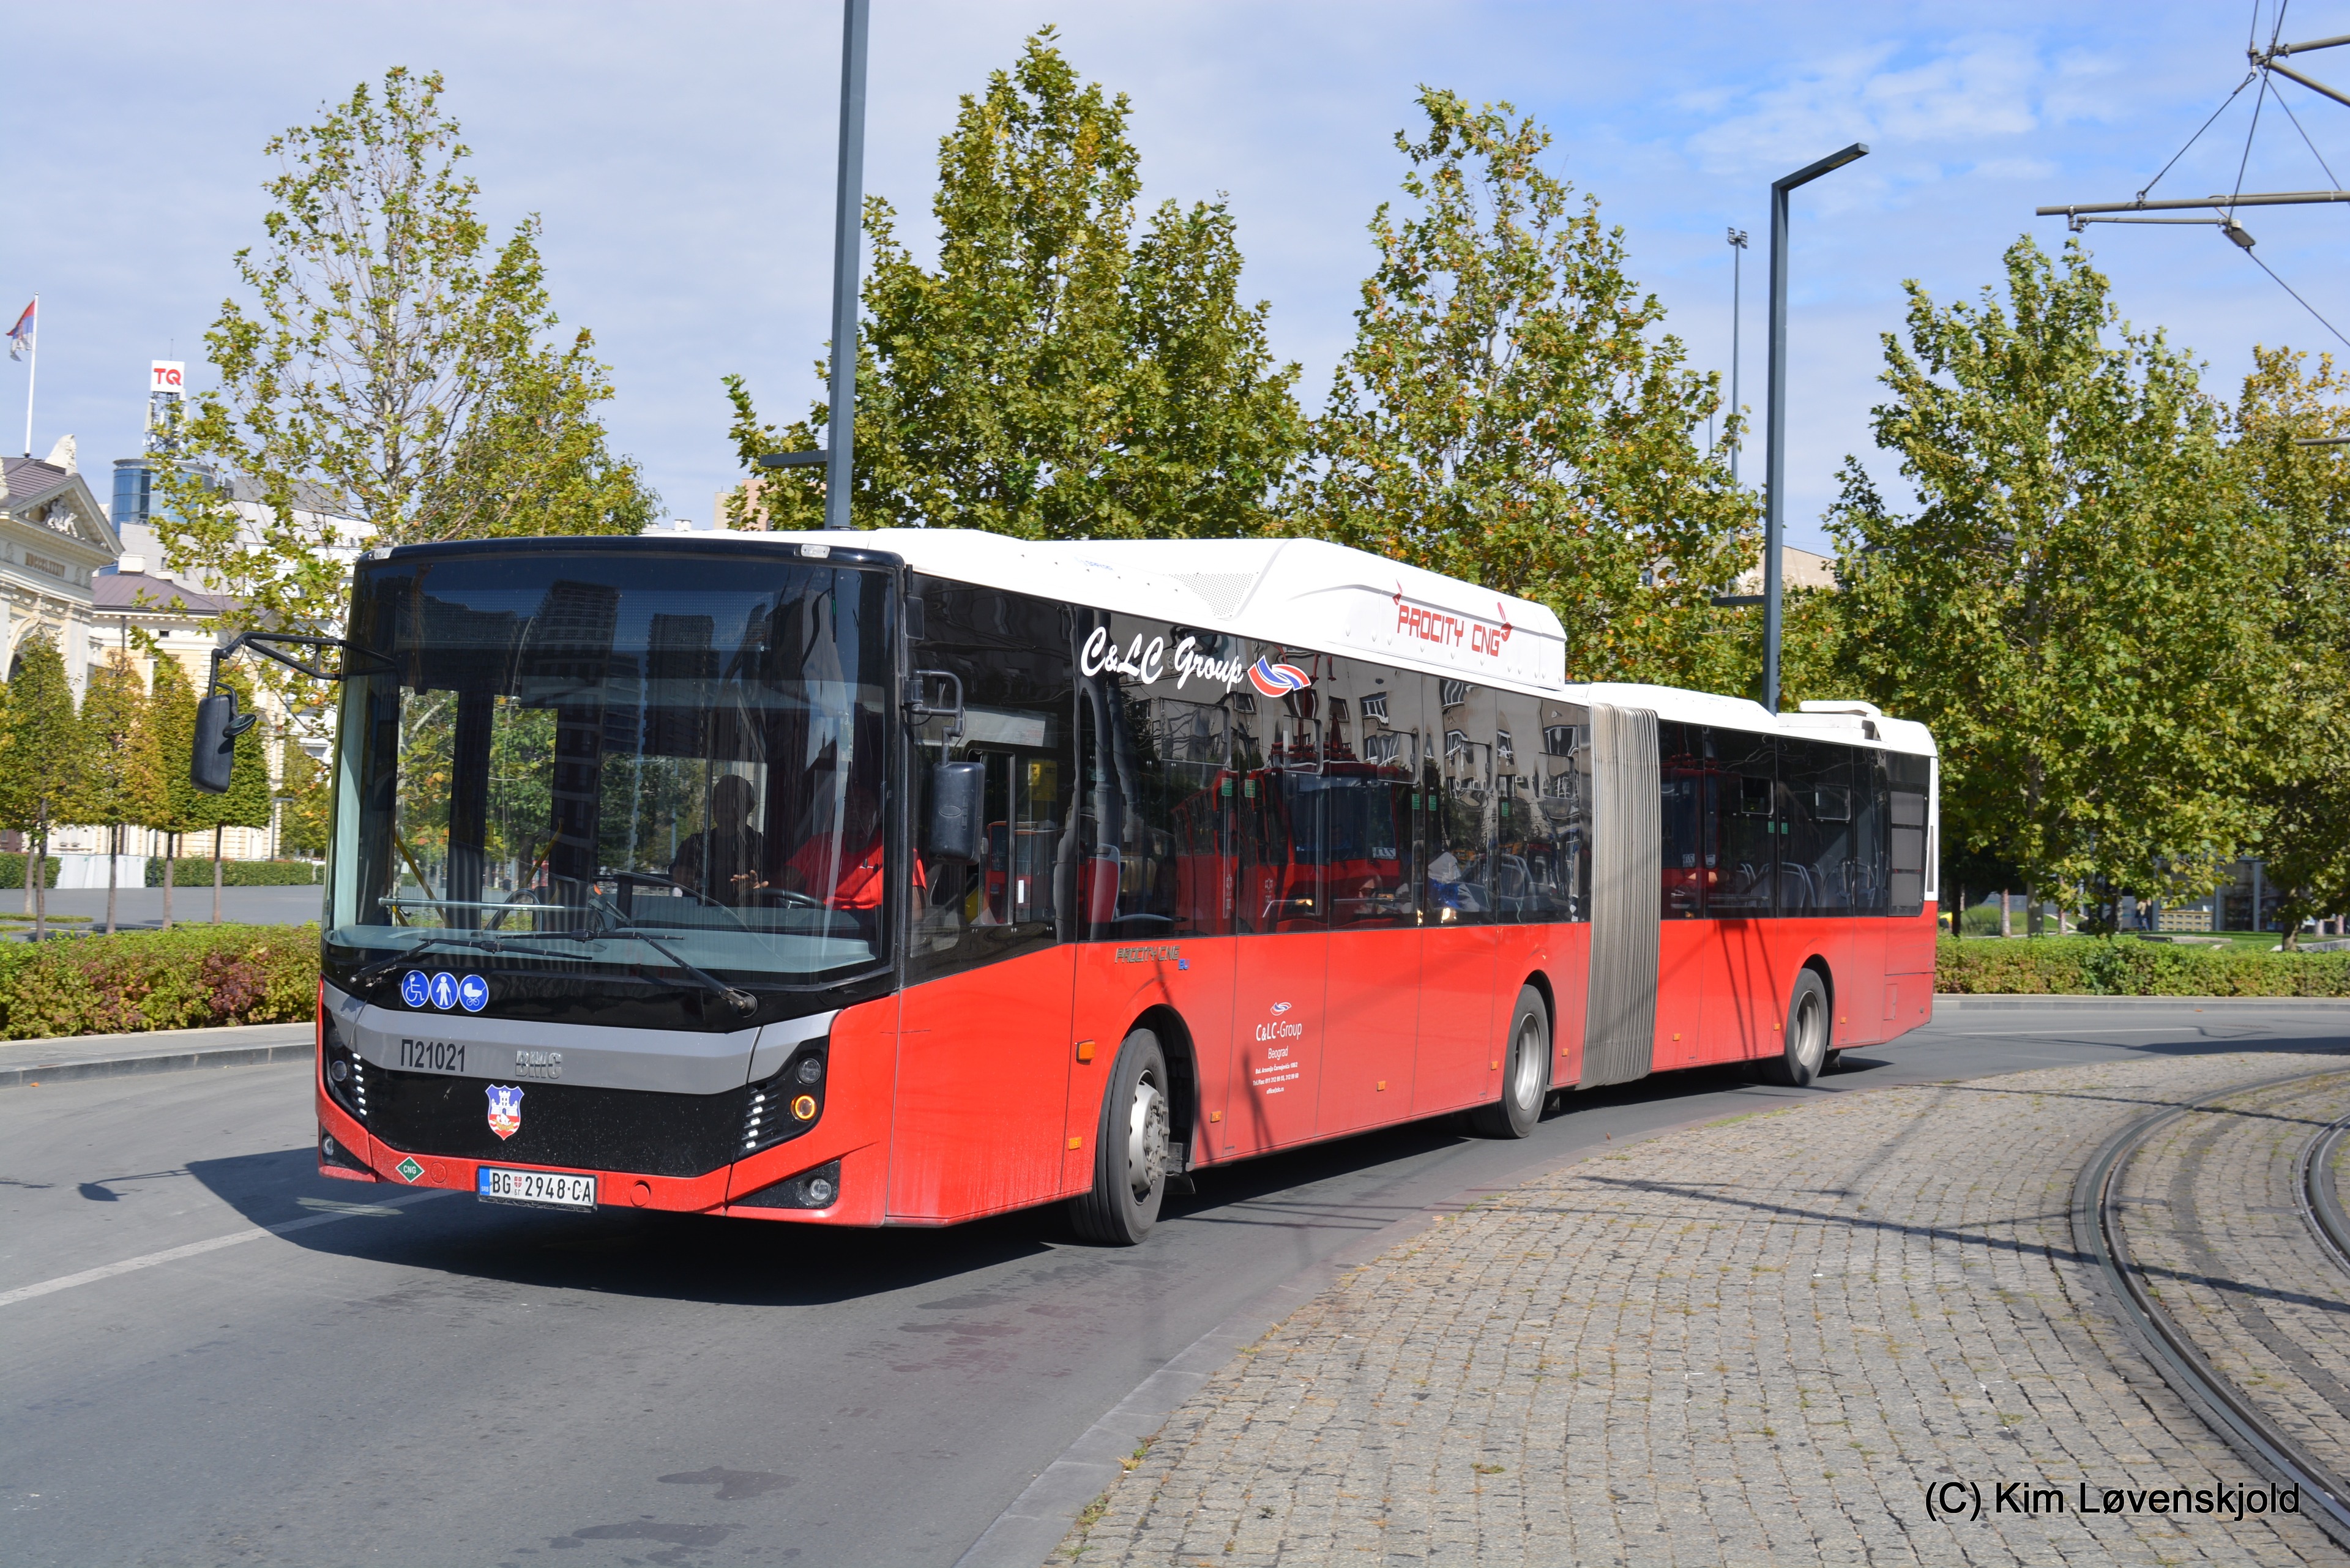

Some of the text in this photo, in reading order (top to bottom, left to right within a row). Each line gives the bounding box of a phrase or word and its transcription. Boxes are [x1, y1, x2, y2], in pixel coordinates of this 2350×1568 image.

[154, 368, 181, 386] TQ
[1397, 605, 1501, 657] PROCITY CNG
[1081, 626, 1244, 693] C&LC Group
[1114, 946, 1181, 963] PROCITY CNG
[1178, 959, 1190, 970] EU
[1268, 1045, 1288, 1061] Beograd
[515, 1050, 562, 1079] BMC
[403, 1165, 416, 1174] CNG
[493, 1173, 511, 1194] BG
